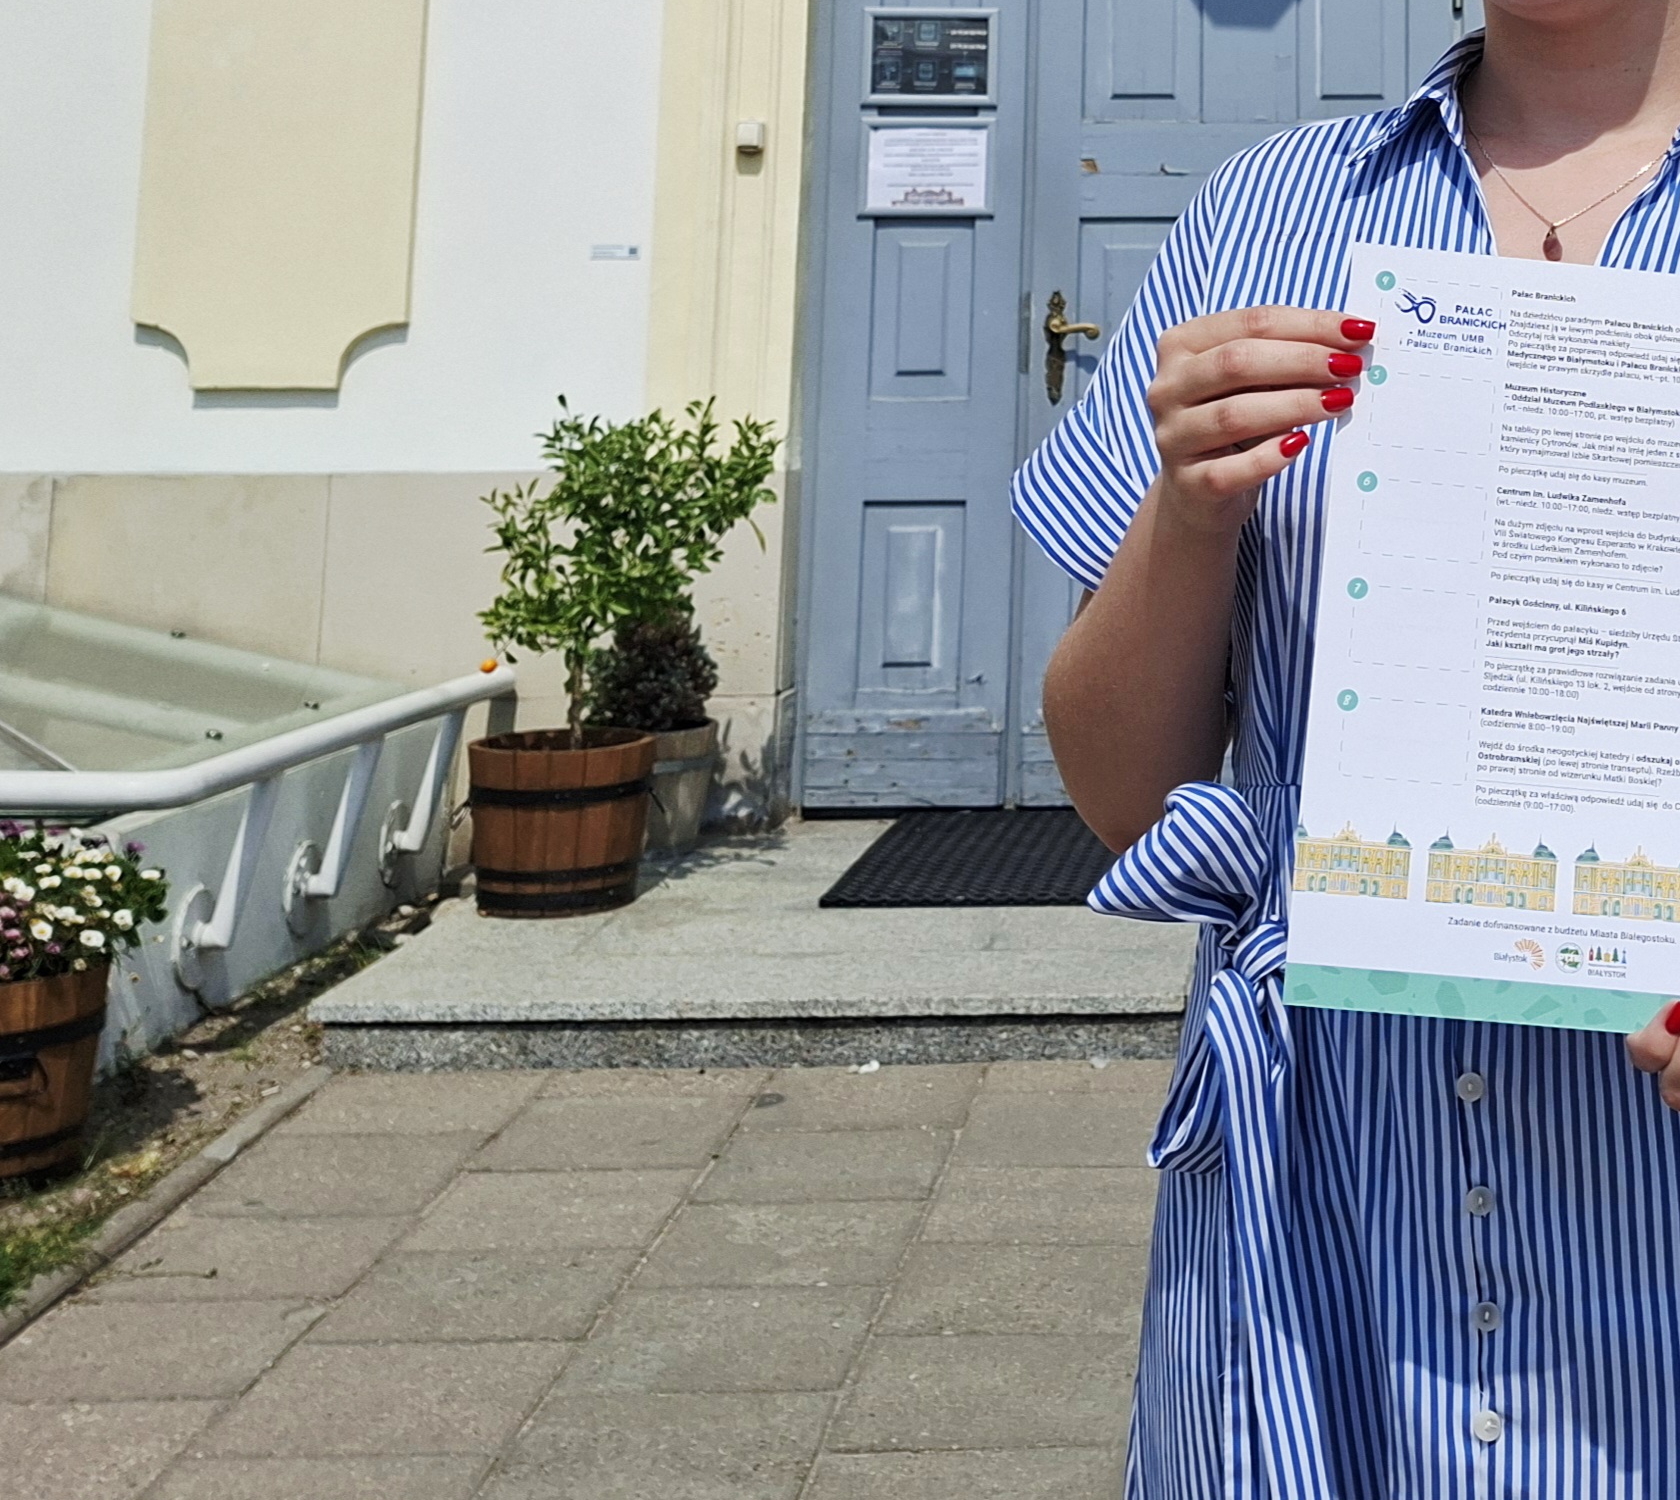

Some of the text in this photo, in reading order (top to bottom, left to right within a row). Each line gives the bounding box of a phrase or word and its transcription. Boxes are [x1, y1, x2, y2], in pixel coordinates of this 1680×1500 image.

[1511, 289, 1576, 302] Pałac Branickich
[1455, 305, 1493, 316] PAŁAC
[1440, 316, 1506, 330] BRANICKICH
[1604, 318, 1630, 328] Pałacu
[1633, 321, 1673, 332] Branickich
[1417, 329, 1484, 343] Muzeum UMB
[1444, 343, 1492, 356] Branickich
[1507, 349, 1556, 362] Medycznego
[1566, 355, 1614, 368] Białymstoku
[1621, 360, 1647, 370] Pałacu
[1504, 382, 1586, 398] Muzeum Historyczne
[1511, 393, 1541, 402] Oddział
[1543, 396, 1576, 406] Muzeum
[1578, 399, 1626, 412] Podlaskiego
[1496, 486, 1626, 505] Centrum im. Ludwika Zamenhofa
[1488, 596, 1520, 607] Pałacyk
[1563, 602, 1572, 610] ul.
[1574, 603, 1619, 616] Kilińskiego
[1485, 639, 1502, 648] Jaki
[1549, 644, 1565, 655] grot
[1567, 646, 1584, 656] jego
[1587, 648, 1619, 659] strzały?
[1480, 707, 1512, 717] Katedra
[1630, 720, 1651, 729] Marii
[1653, 722, 1678, 733] Panny
